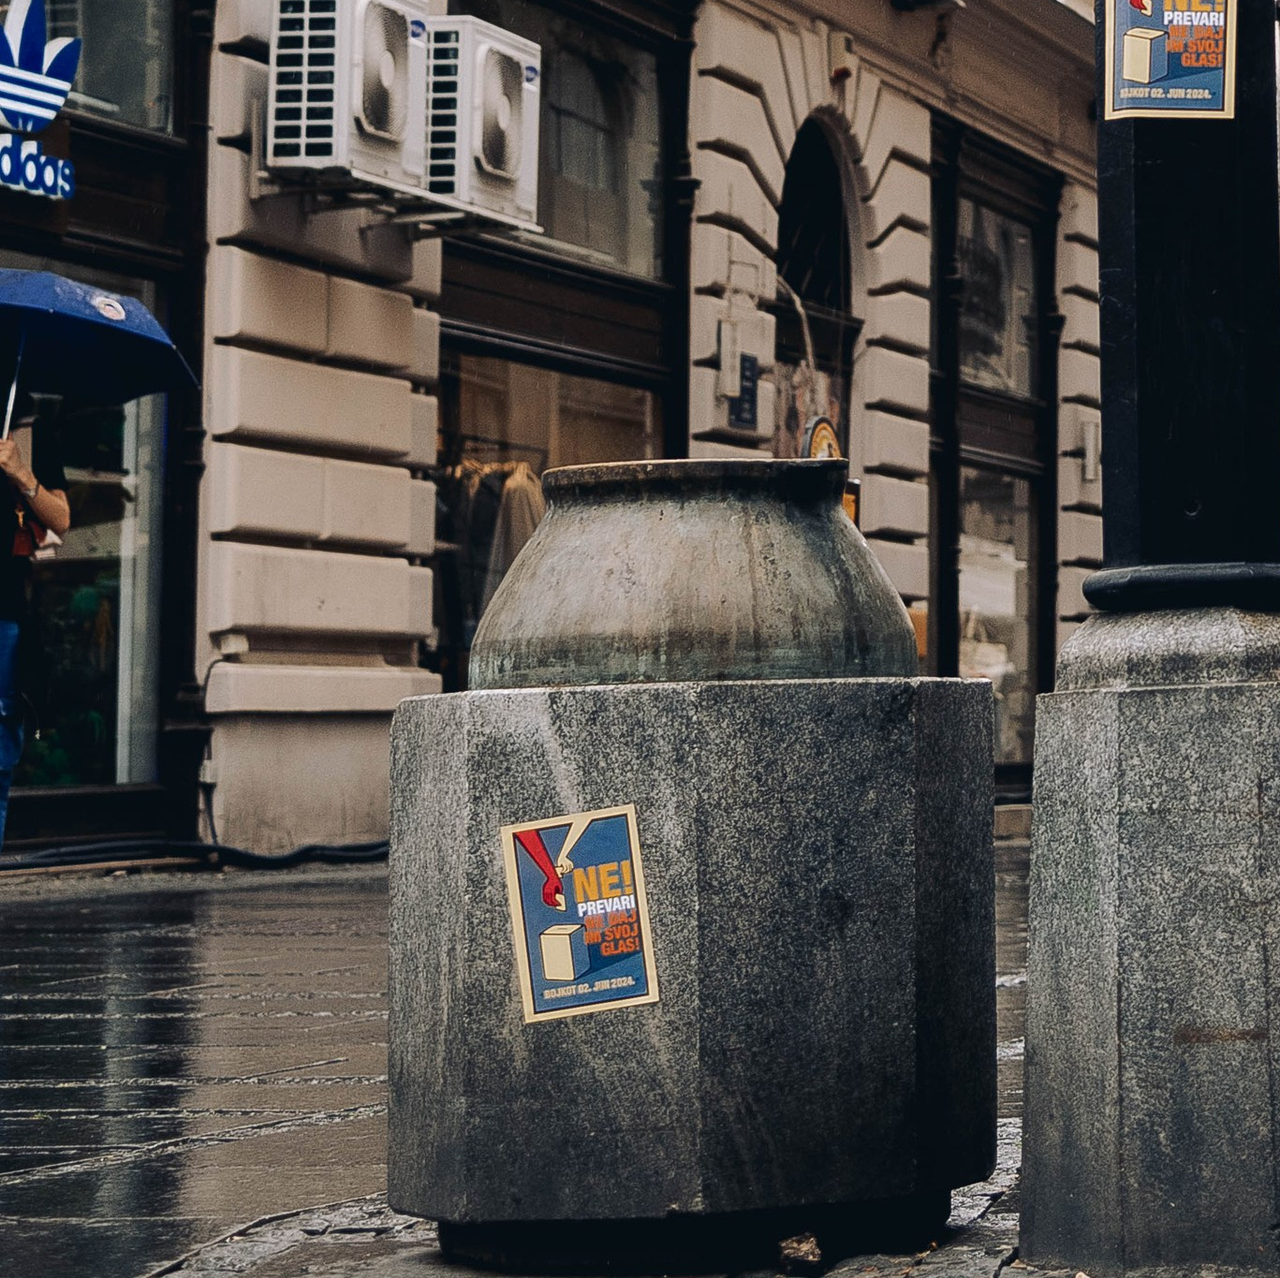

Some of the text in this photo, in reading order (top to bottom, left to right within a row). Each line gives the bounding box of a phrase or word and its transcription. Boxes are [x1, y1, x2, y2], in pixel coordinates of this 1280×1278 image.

[1163, 11, 1224, 25] PREVARI
[1193, 25, 1224, 40] DAJ
[1187, 40, 1224, 53] SVOJ
[1181, 52, 1223, 68] GLAS!
[573, 860, 634, 903] NE!
[577, 894, 636, 917] PREVARI
[608, 907, 637, 926] DAJ
[604, 923, 639, 941] SVOJ
[601, 937, 640, 956] GLAS!
